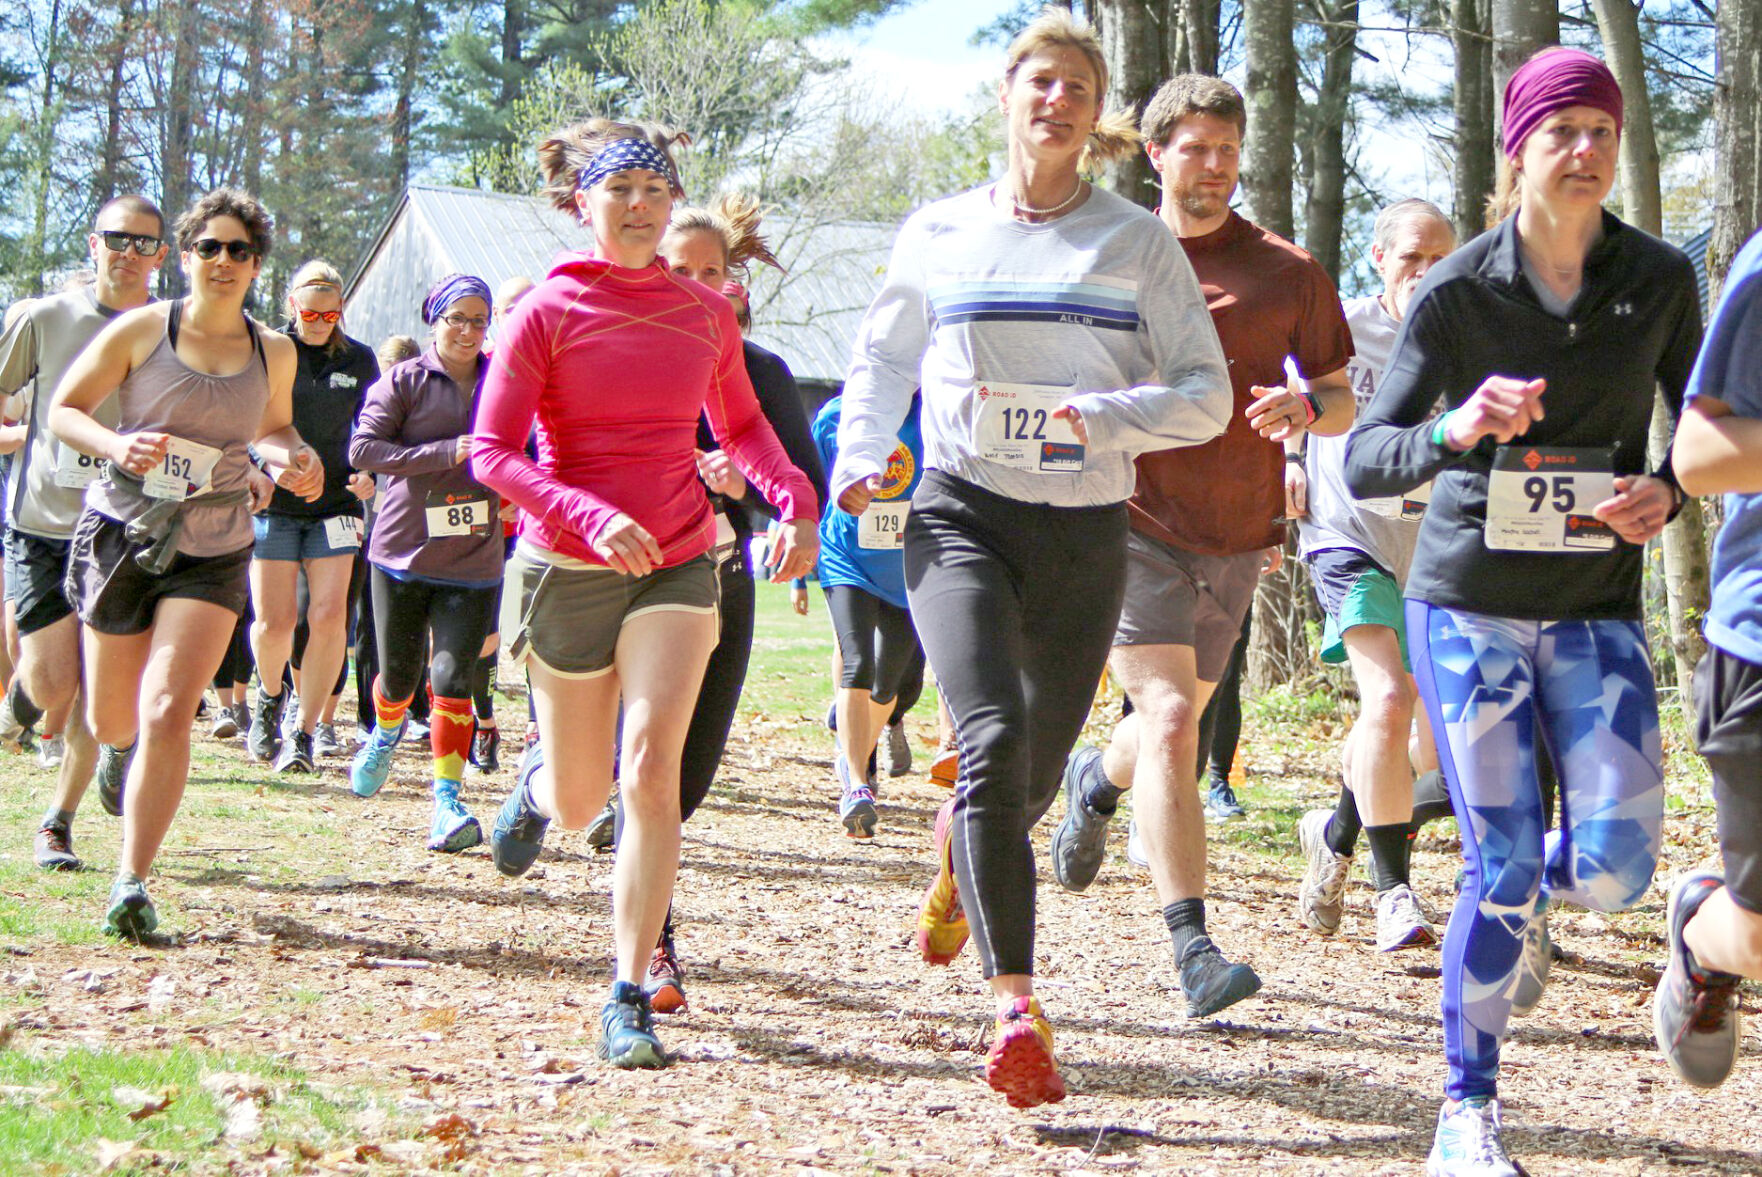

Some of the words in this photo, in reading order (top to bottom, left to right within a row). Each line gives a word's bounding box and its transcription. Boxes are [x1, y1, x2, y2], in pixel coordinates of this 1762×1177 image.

[1060, 313, 1080, 323] ALL
[1083, 317, 1093, 325] IN
[1002, 407, 1047, 440] 122
[163, 453, 191, 481] 152
[1523, 476, 1576, 513] 95
[447, 505, 474, 527] 88
[875, 514, 899, 532] 129
